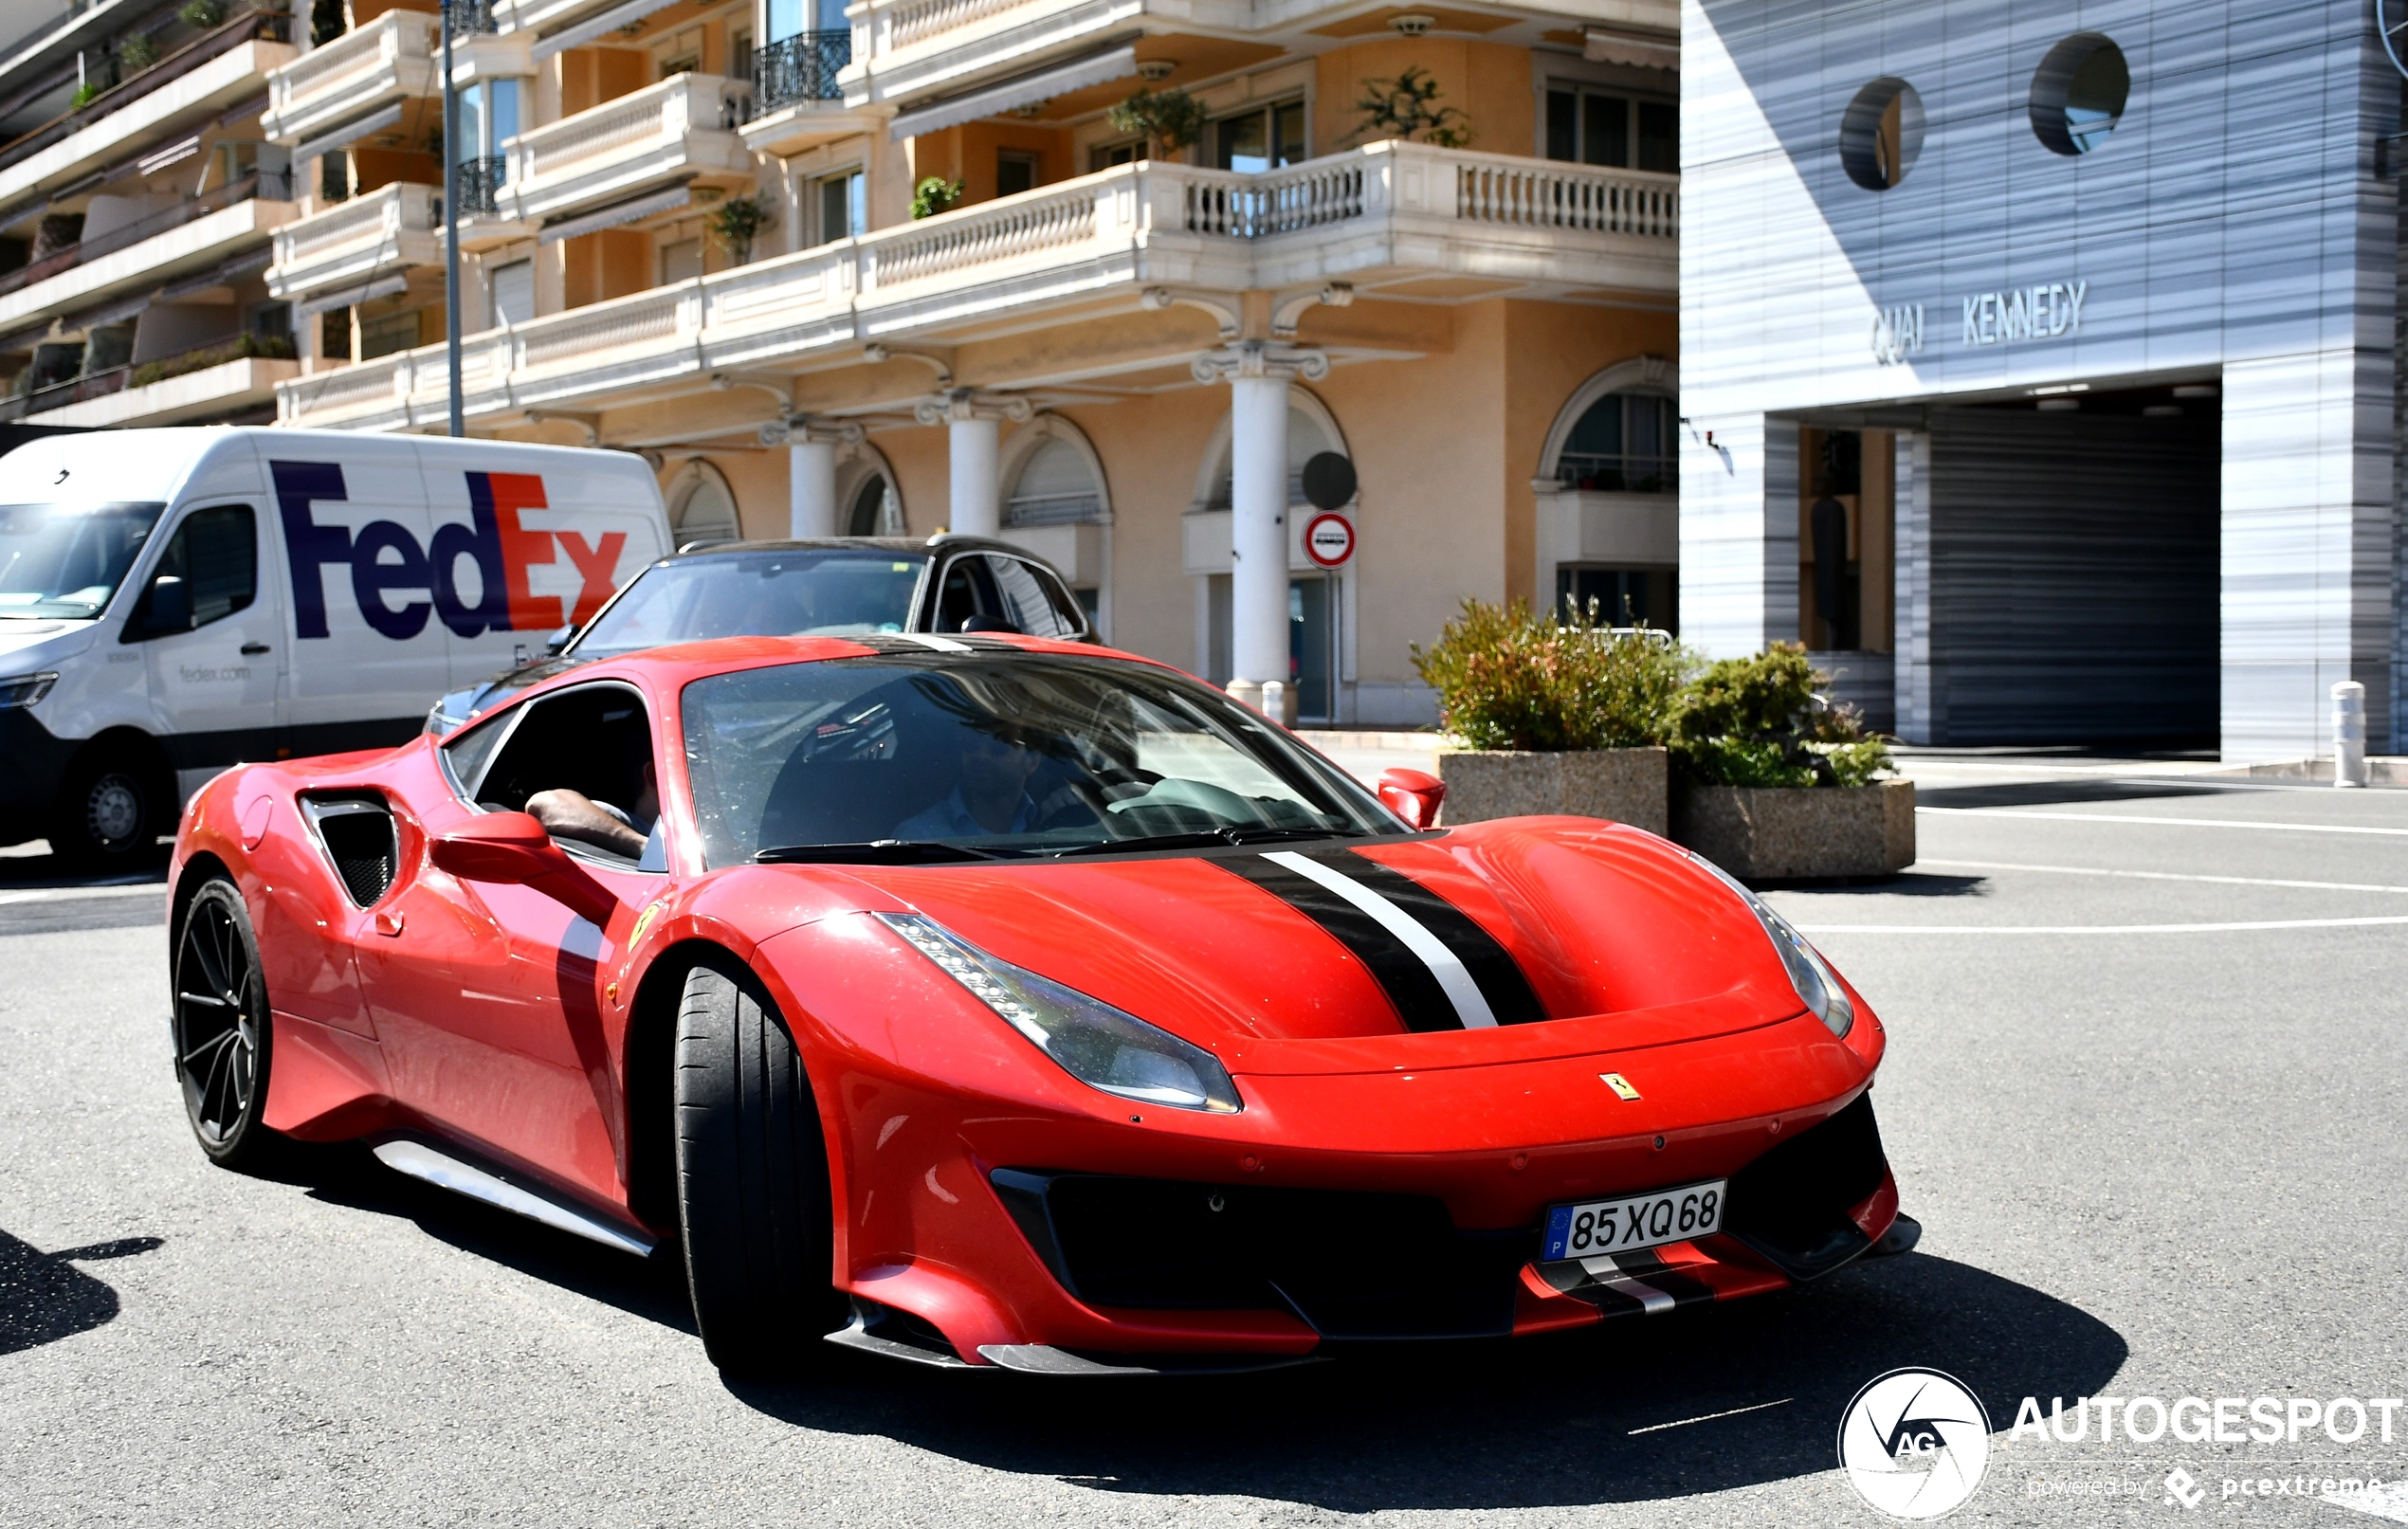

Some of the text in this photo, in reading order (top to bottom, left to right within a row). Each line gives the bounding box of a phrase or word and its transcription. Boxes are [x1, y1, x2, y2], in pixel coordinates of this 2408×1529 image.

[1870, 280, 2088, 365] QUAI KENNEDY
[269, 460, 628, 640] FedEx
[179, 664, 252, 683] fedex.com
[1552, 1241, 1561, 1254] P
[1572, 1190, 1719, 1250] 85 XQ 68
